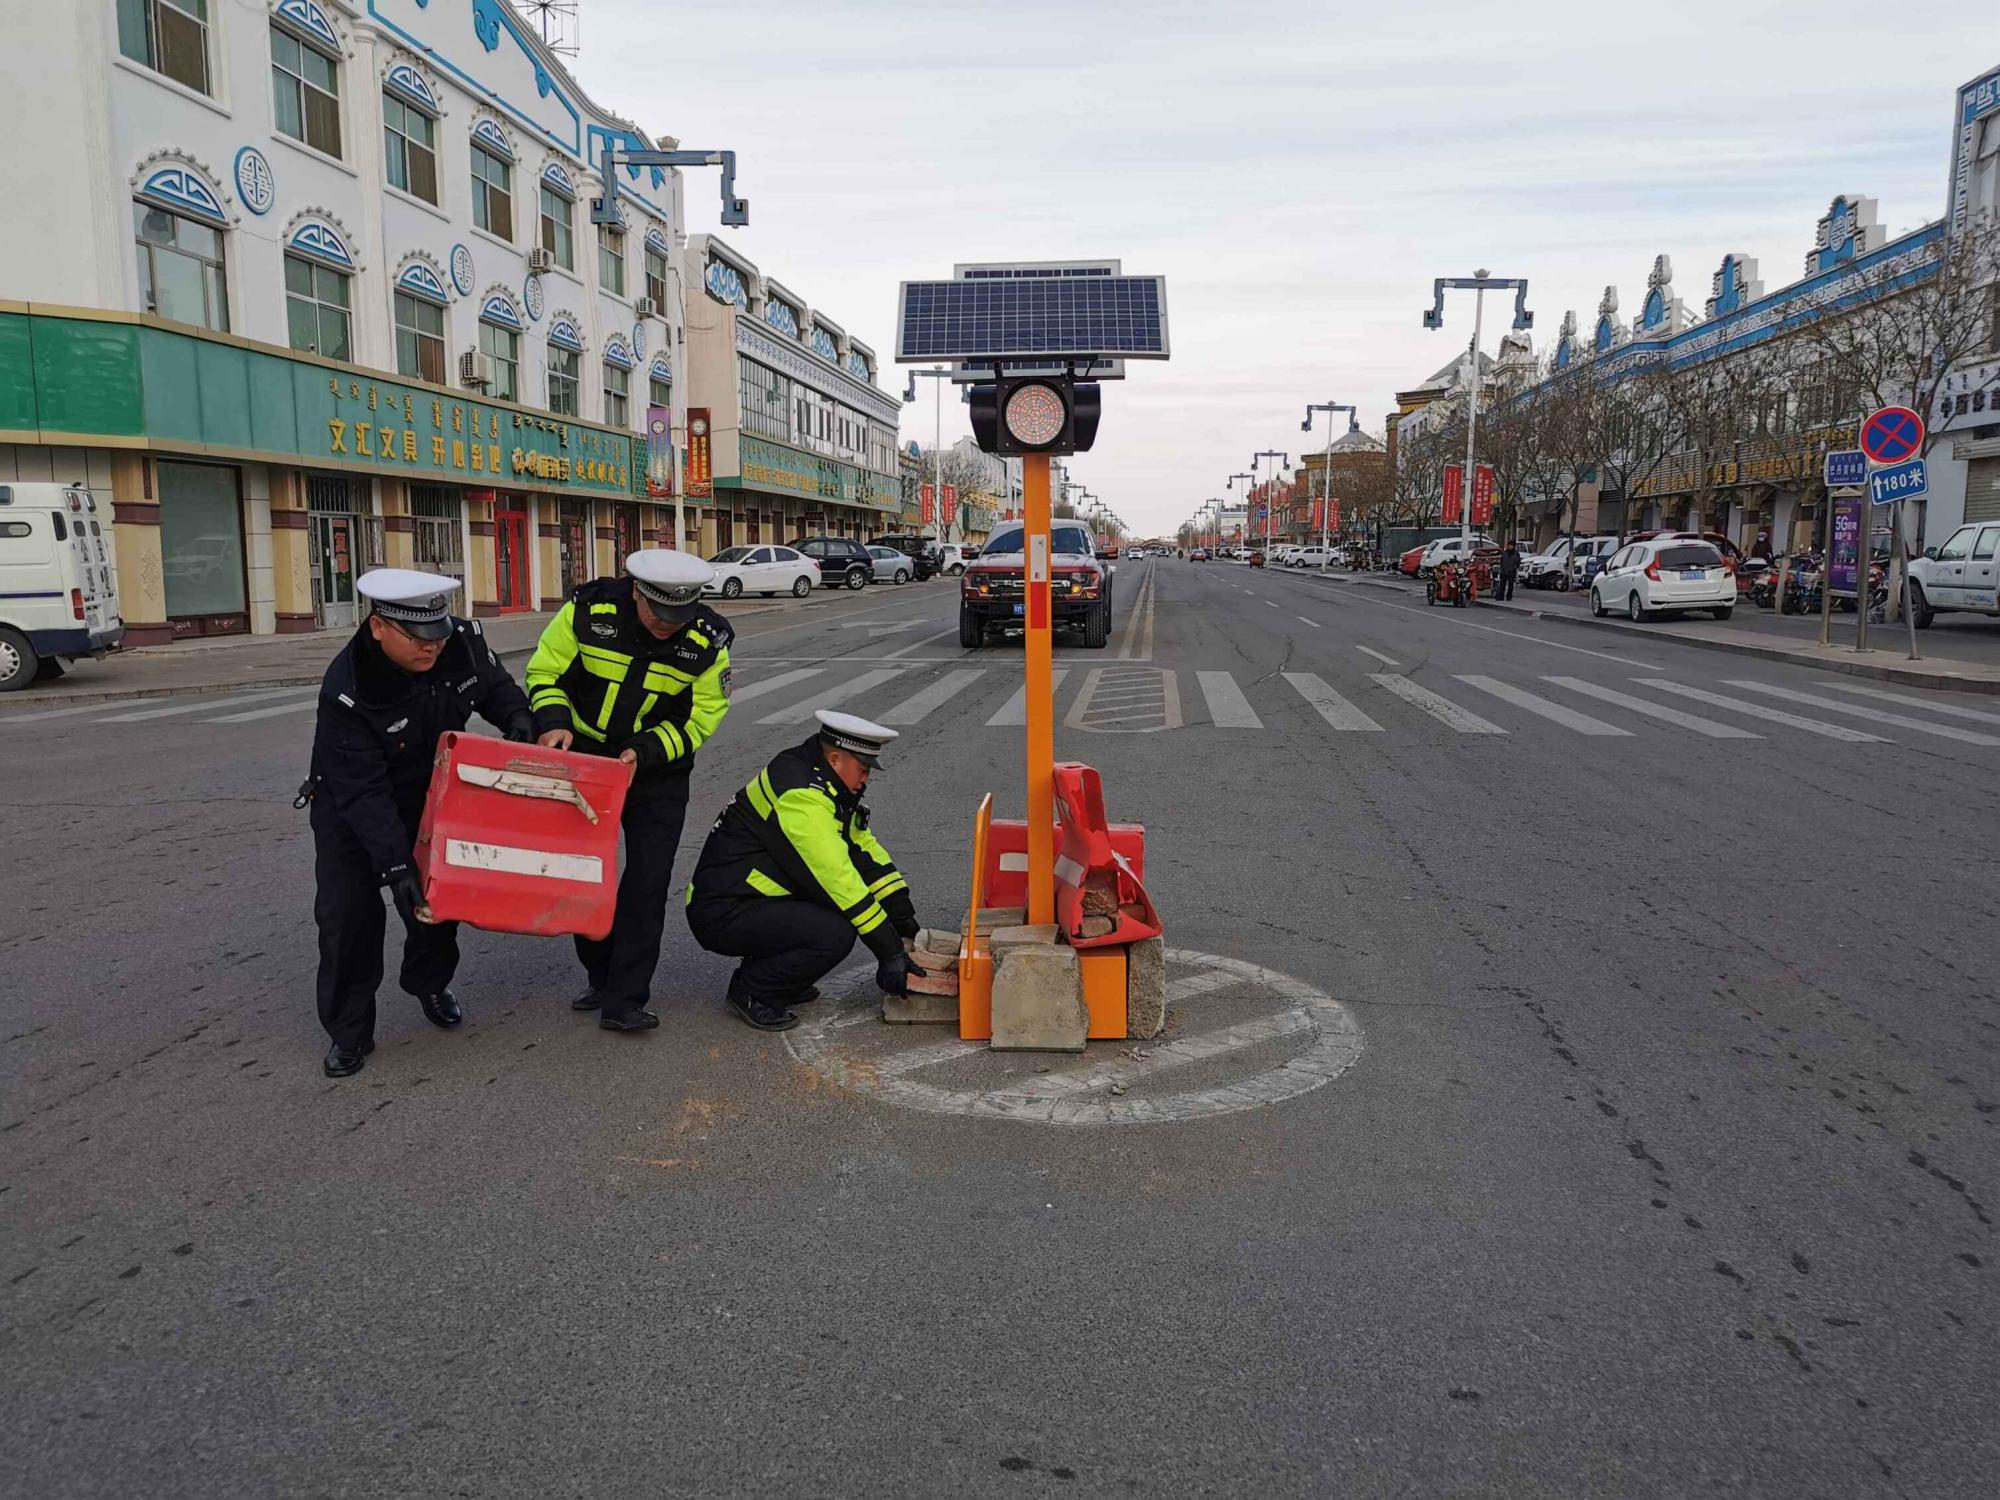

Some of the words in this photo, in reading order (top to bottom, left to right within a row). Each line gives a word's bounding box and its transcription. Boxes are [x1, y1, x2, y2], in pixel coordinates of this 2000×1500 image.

[328, 417, 417, 463] 文汇文具
[432, 435, 501, 473] 开心彩吧
[1883, 468, 1923, 492] 180米
